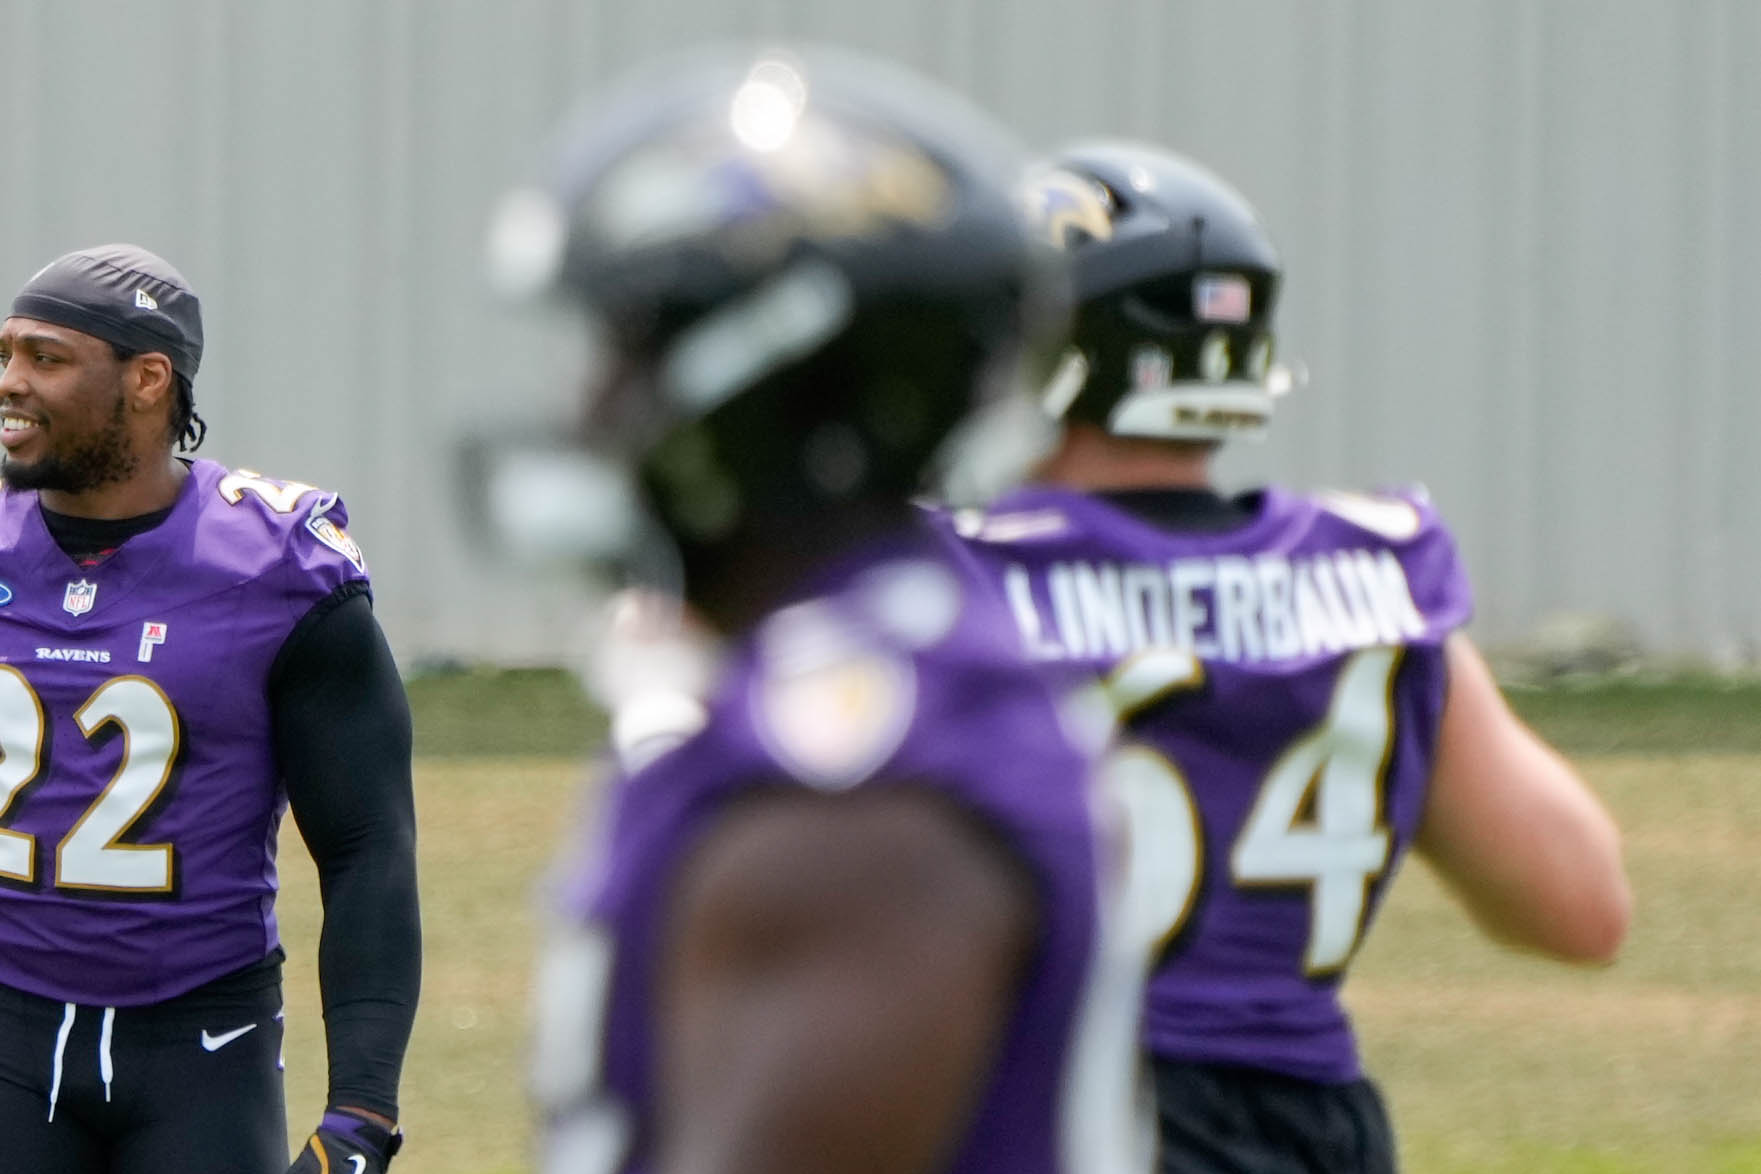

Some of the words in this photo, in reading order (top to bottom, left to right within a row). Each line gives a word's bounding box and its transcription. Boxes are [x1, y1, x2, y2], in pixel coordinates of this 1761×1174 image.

[69, 595, 88, 608] NFL
[1004, 549, 1427, 663] LINDERBAUM
[35, 647, 111, 663] RAVENS
